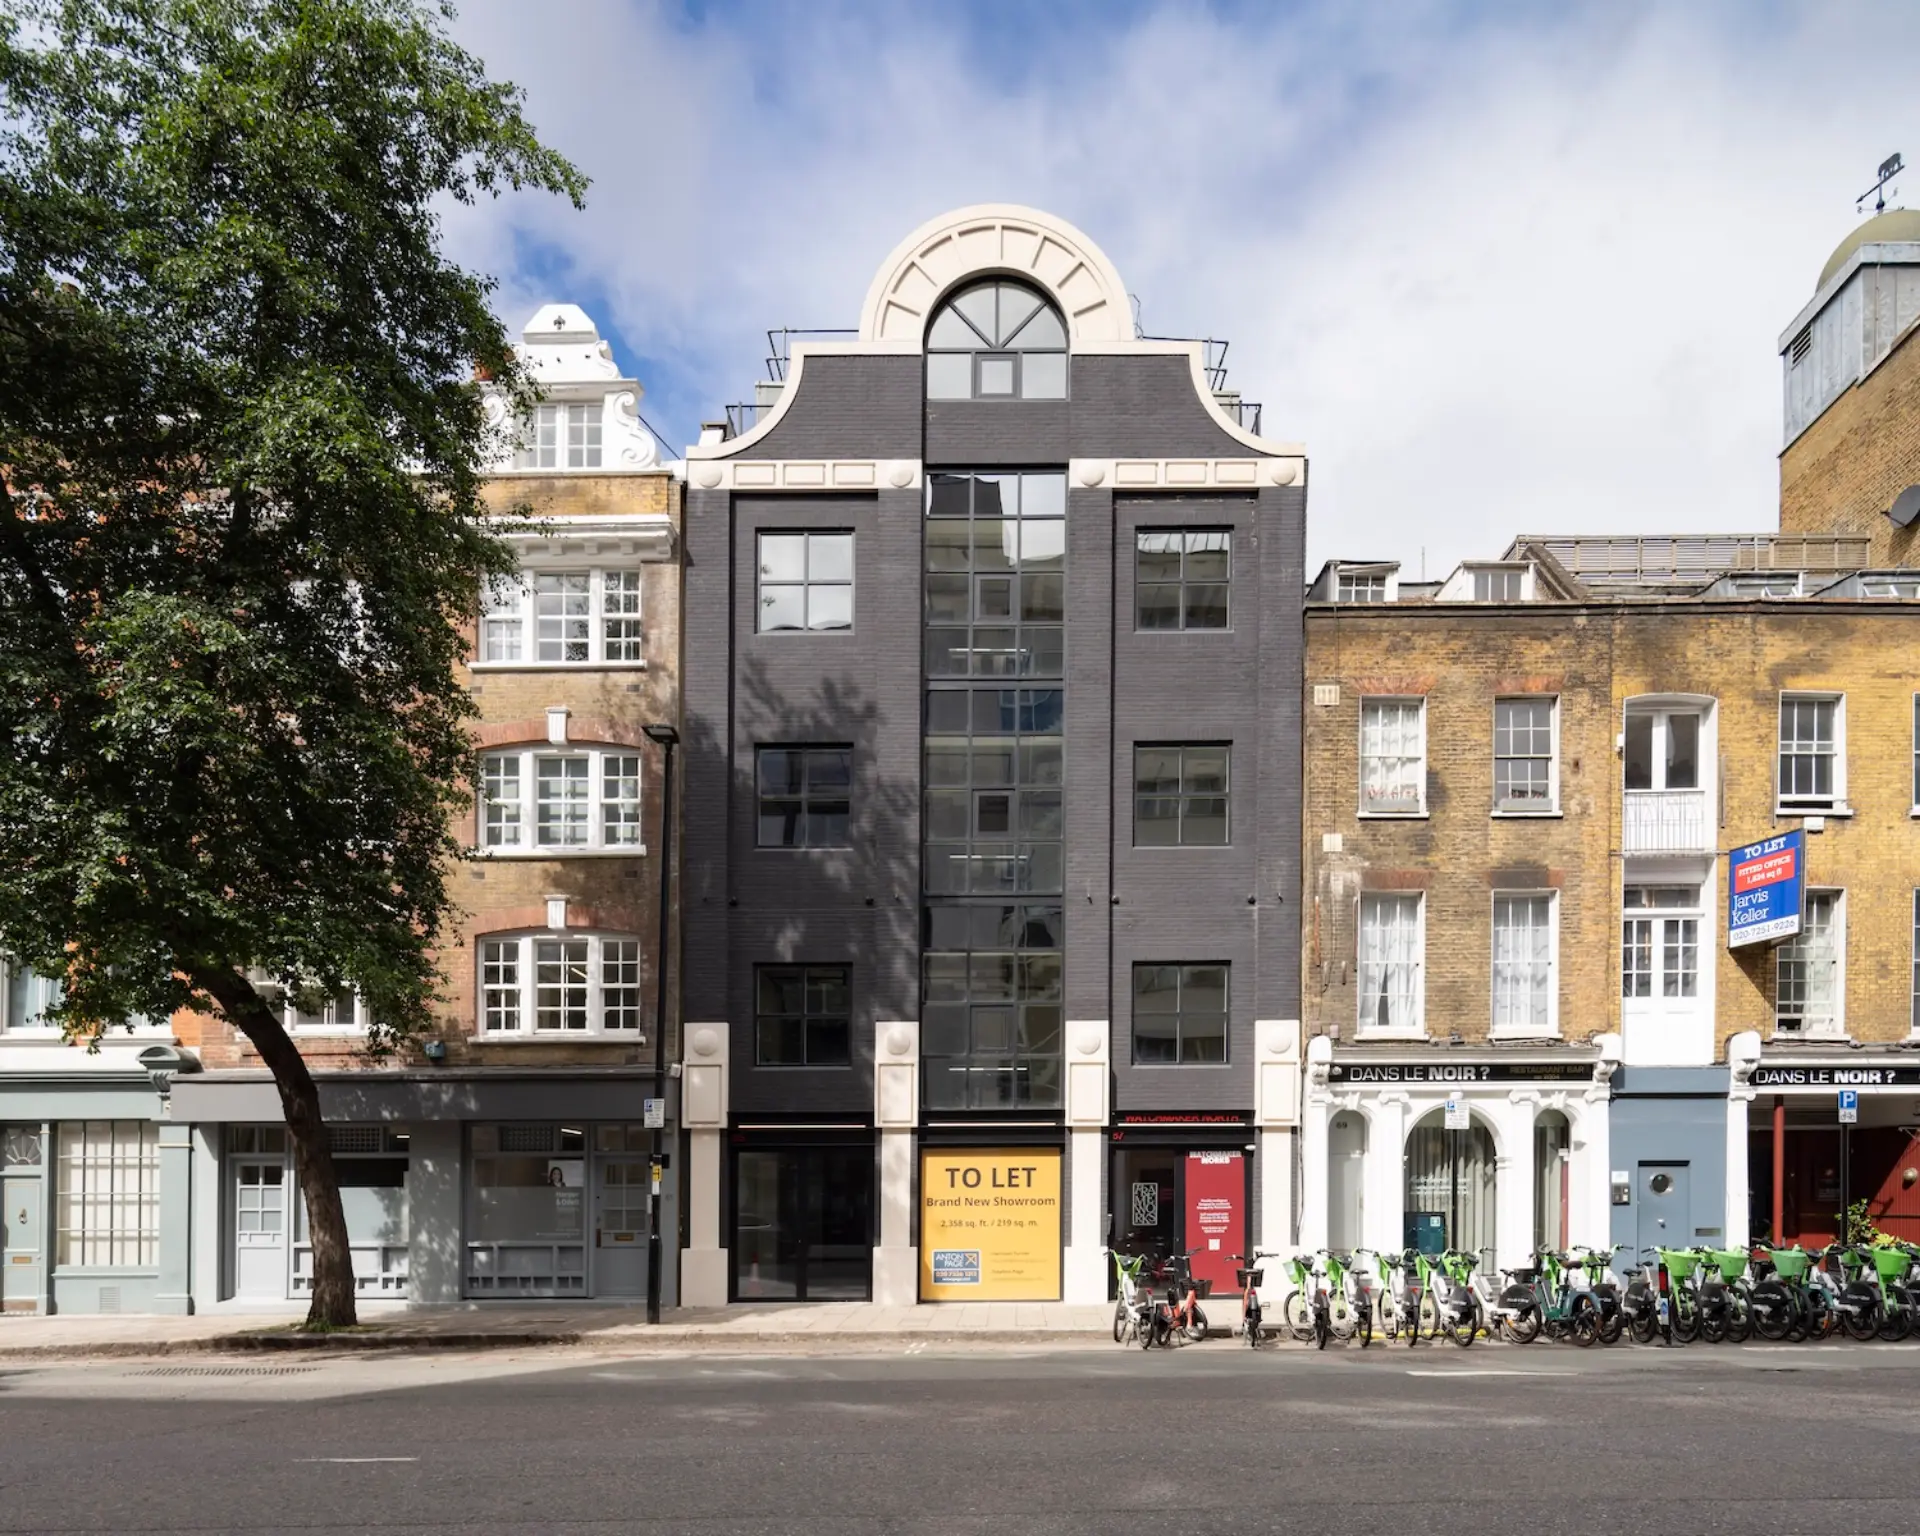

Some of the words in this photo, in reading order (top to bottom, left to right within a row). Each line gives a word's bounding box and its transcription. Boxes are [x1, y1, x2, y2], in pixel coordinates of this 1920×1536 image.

[1744, 845, 1761, 859] TO
[1764, 837, 1786, 854] LET
[1764, 855, 1792, 869] OFFICE
[1733, 889, 1768, 911] Jarvis
[1732, 907, 1769, 926] Keller
[1350, 1067, 1399, 1081] DANS
[1404, 1067, 1424, 1080] LE
[1428, 1066, 1476, 1080] NOIR
[1480, 1066, 1490, 1080] ?
[1510, 1066, 1565, 1074] RESTAURANT
[1567, 1065, 1584, 1074] BAR
[1755, 1069, 1805, 1084] DANS
[1810, 1070, 1829, 1084] LE
[1834, 1069, 1882, 1083] NOIR
[1885, 1069, 1896, 1083] ?
[1843, 1092, 1855, 1108] P
[945, 1167, 981, 1188] TO
[992, 1167, 1037, 1188] LET
[926, 1197, 961, 1207] Brand
[965, 1197, 990, 1207] New
[993, 1196, 1055, 1206] Showroom
[941, 1220, 963, 1228] 2,358
[965, 1220, 977, 1229] sq.
[979, 1219, 989, 1227] ft.
[996, 1219, 1012, 1227] 219
[944, 1260, 964, 1268] PAGE
